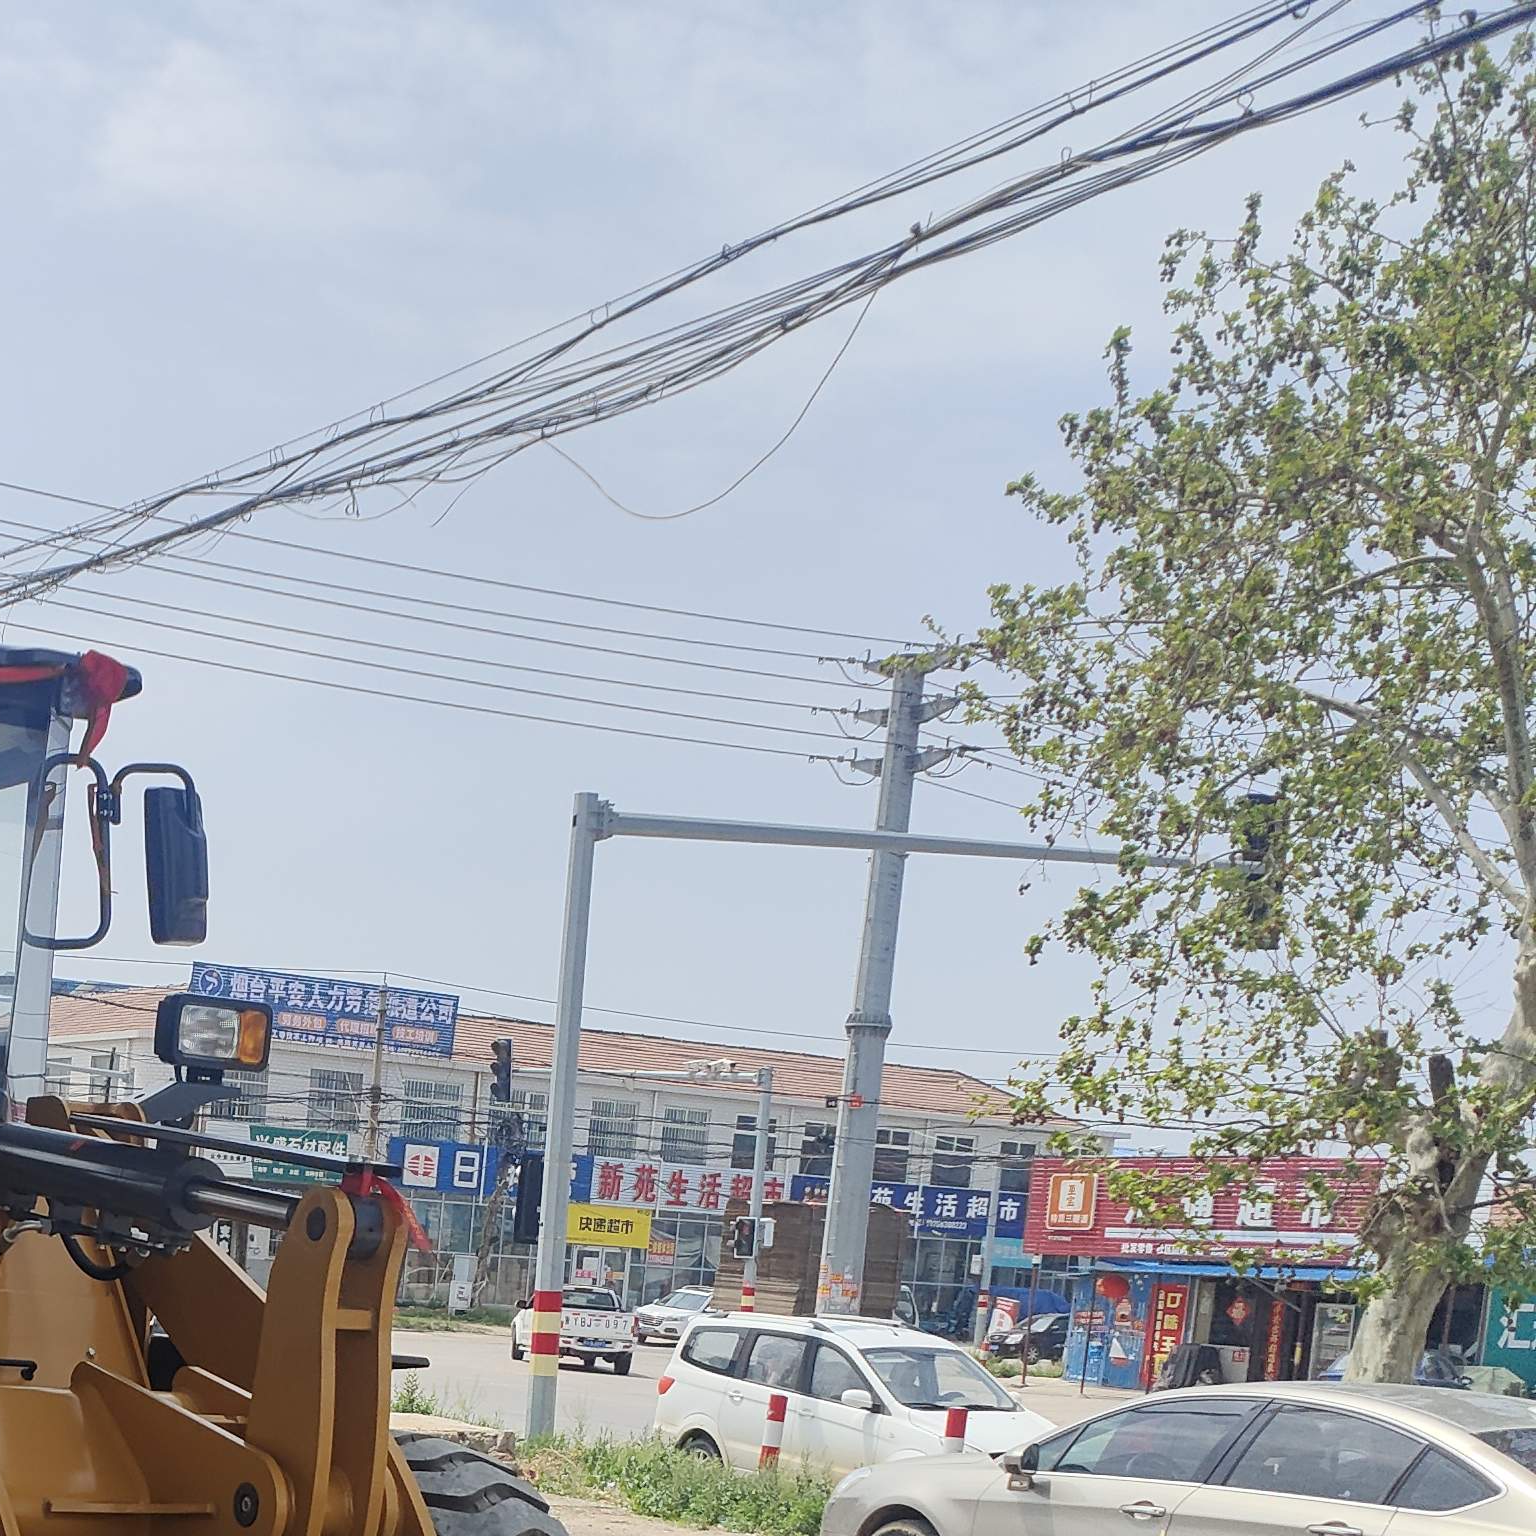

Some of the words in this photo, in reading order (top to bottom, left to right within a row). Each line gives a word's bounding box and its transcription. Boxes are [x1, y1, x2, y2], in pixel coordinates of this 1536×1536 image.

[597, 1161, 785, 1210] 新苑生活超市
[579, 1216, 634, 1235] 快递超市
[1497, 1303, 1536, 1350] 汇
